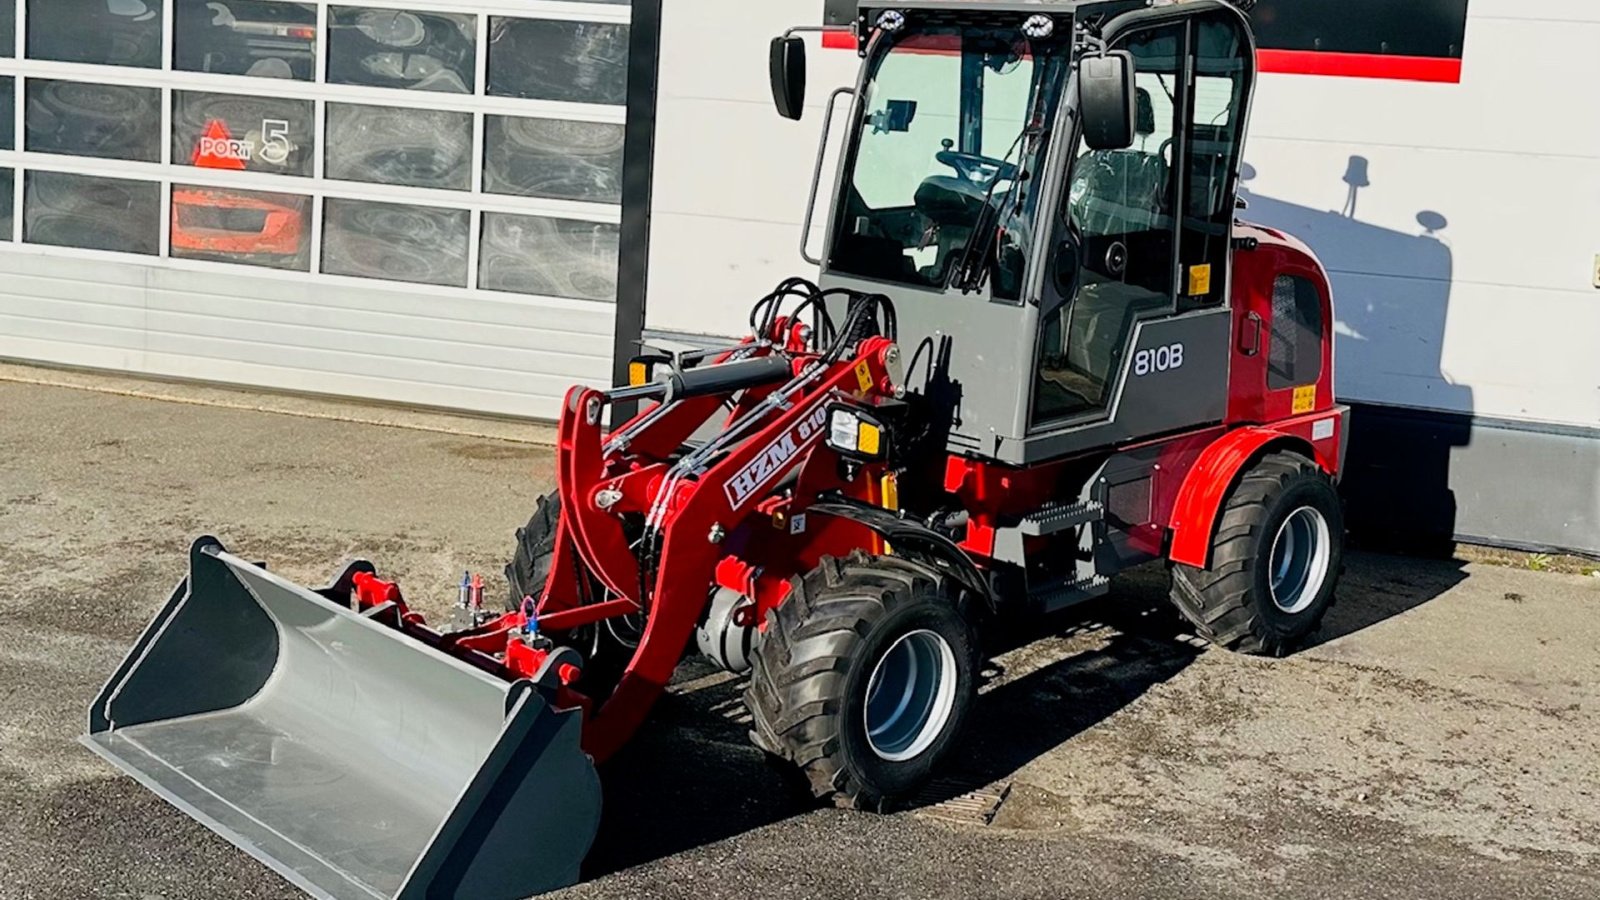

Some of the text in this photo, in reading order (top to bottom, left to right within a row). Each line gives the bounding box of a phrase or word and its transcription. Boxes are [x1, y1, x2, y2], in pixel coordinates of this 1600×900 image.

[201, 119, 289, 163] PORT 5
[1135, 343, 1184, 375] 810B
[731, 398, 834, 500] HZM 810
